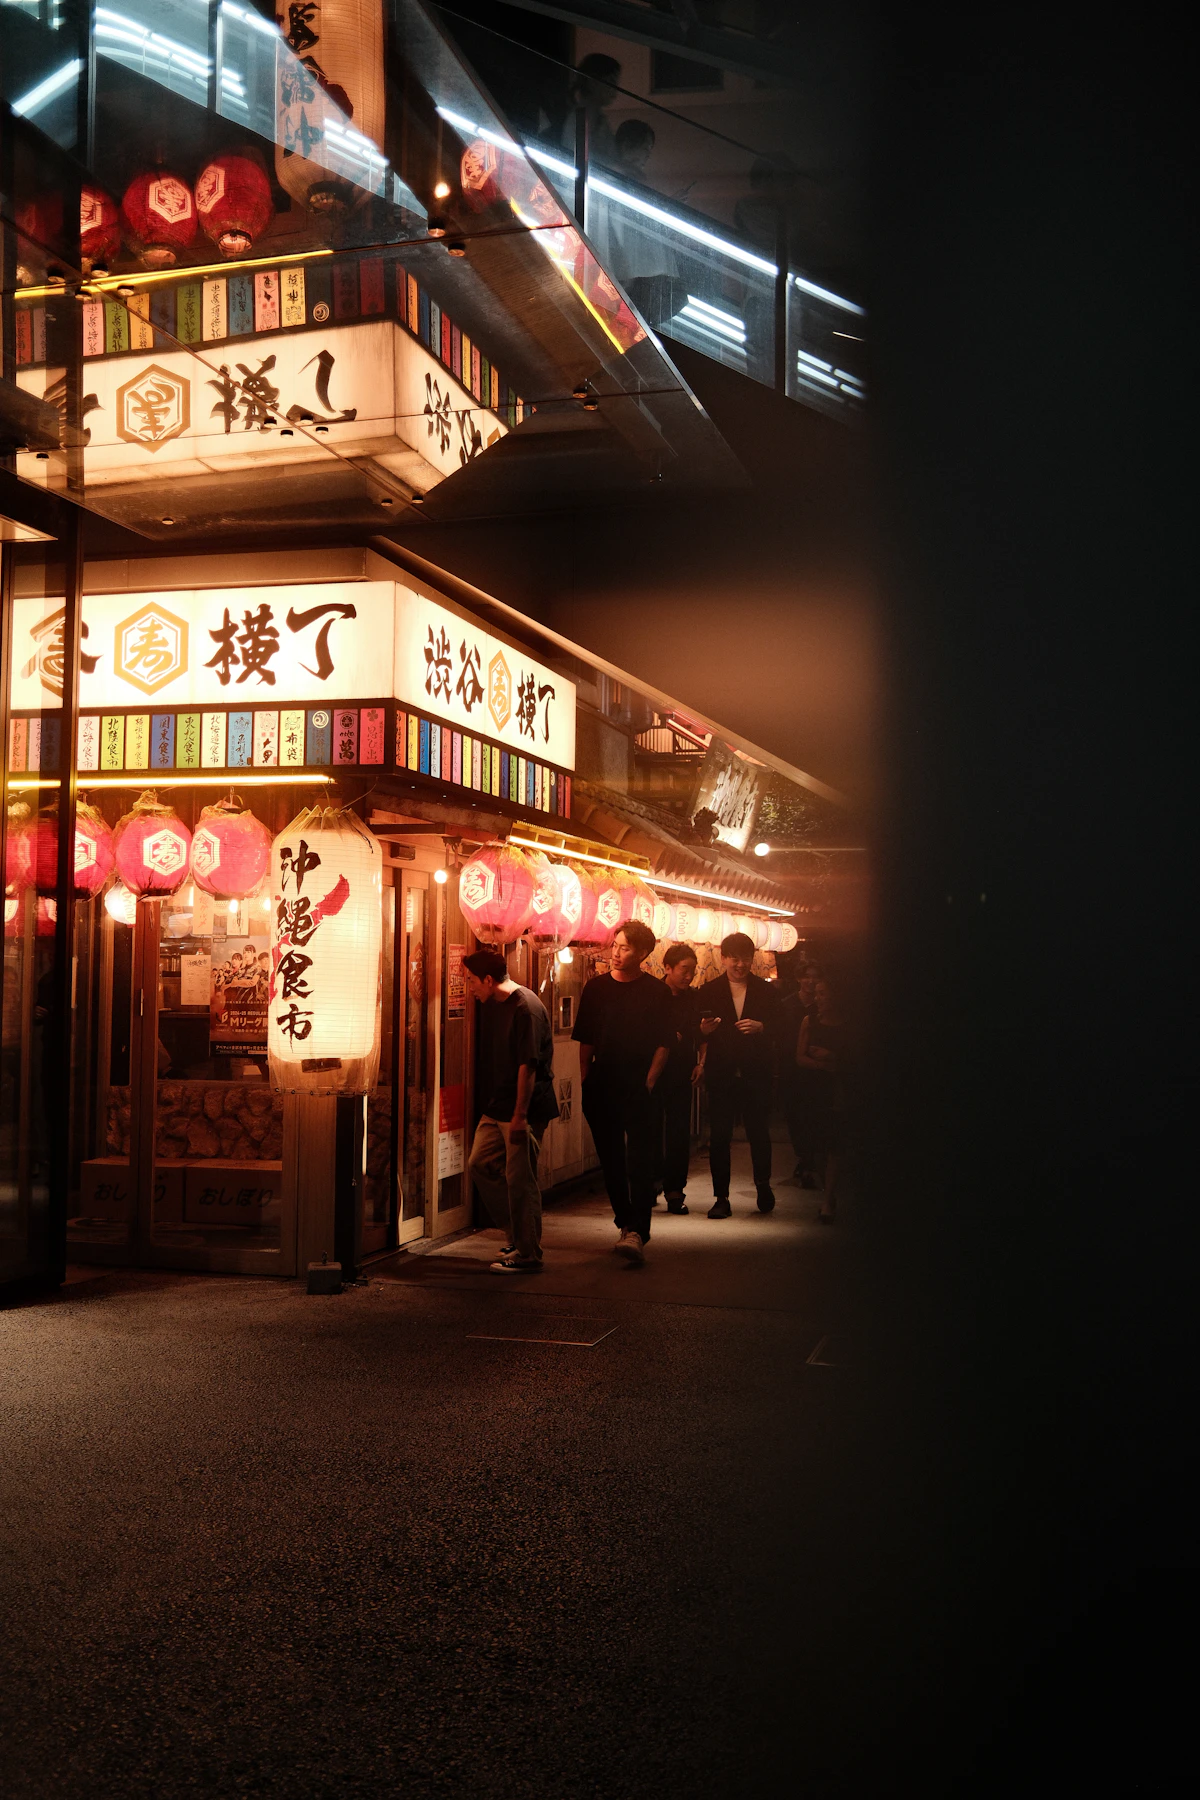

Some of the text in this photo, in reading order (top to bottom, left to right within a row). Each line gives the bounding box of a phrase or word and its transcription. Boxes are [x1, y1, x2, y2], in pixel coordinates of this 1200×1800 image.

[203, 603, 357, 686] 横丁
[423, 624, 486, 713] 渋谷
[515, 669, 556, 745] 横丁
[285, 732, 298, 761] 布袋
[275, 840, 321, 1053] 沖縄食市
[677, 911, 689, 935] Orion
[199, 1187, 274, 1208] おしぼり
